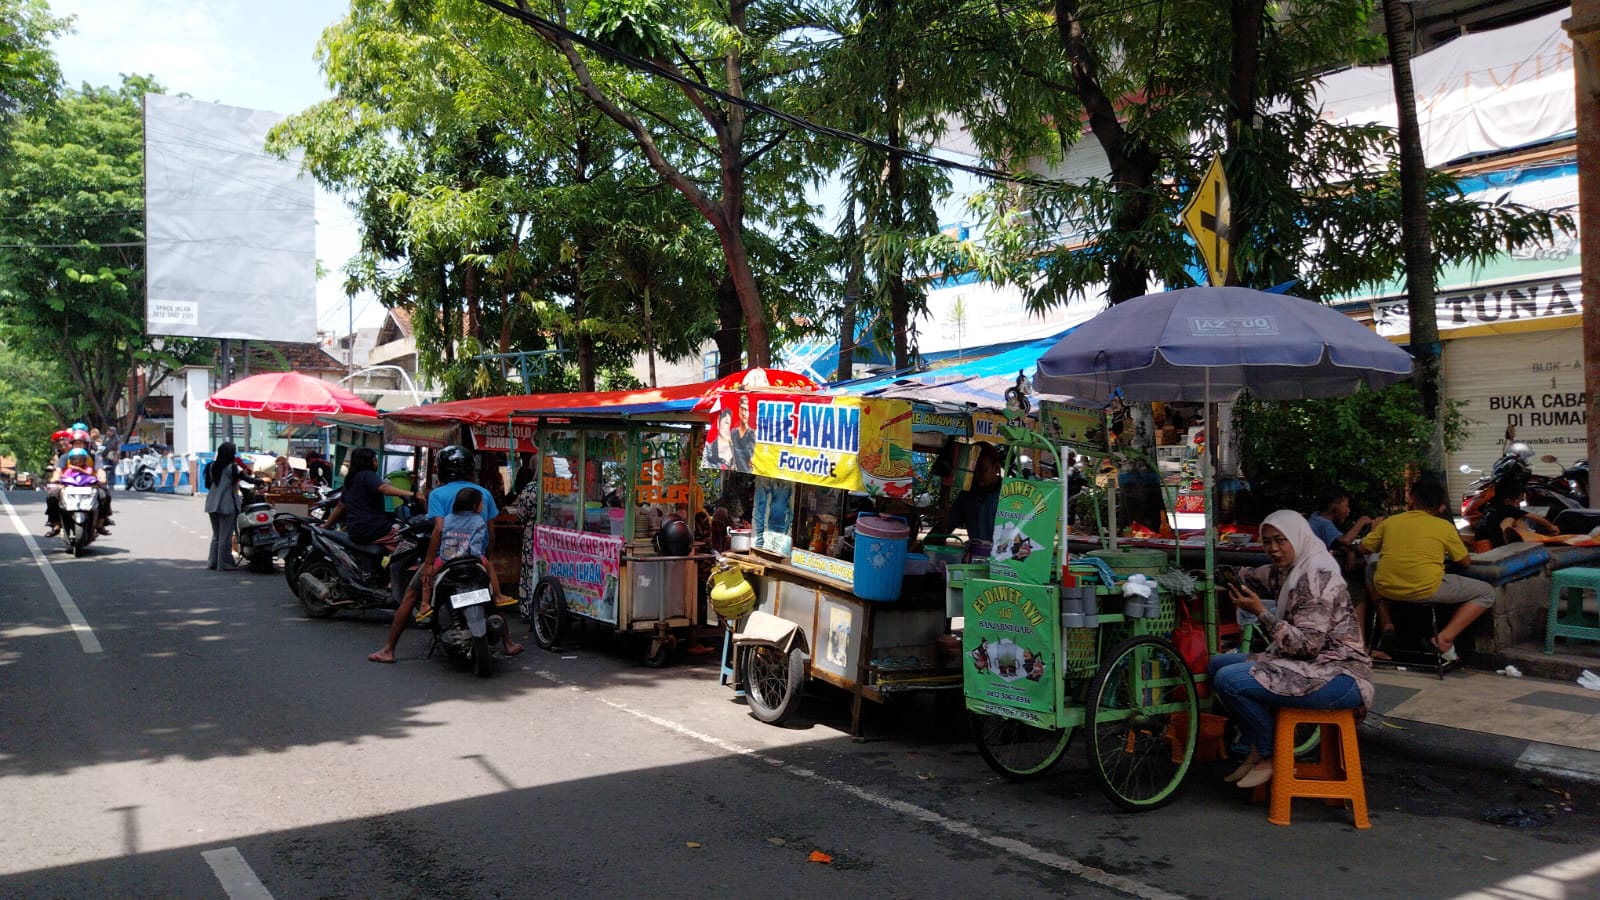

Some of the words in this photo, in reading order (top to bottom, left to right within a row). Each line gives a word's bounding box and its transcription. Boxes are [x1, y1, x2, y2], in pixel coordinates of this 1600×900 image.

[1445, 283, 1578, 323] TUNA
[1533, 362, 1560, 373] BLOK
[1550, 376, 1556, 389] 1
[1490, 395, 1535, 410] BUKA
[757, 401, 794, 445] MIE
[797, 404, 860, 453] AYAM
[924, 413, 954, 428] AYAM
[976, 419, 993, 436] MIE
[1508, 413, 1523, 427] DI
[640, 463, 665, 481] ES
[636, 485, 689, 503] TELER
[1002, 481, 1036, 499] DAWET
[551, 532, 578, 552] TELER
[550, 561, 574, 579] MAMA
[576, 561, 603, 585] ILHAM
[972, 597, 987, 615] ES
[984, 586, 1022, 605] DAWET
[1022, 599, 1044, 626] AYU
